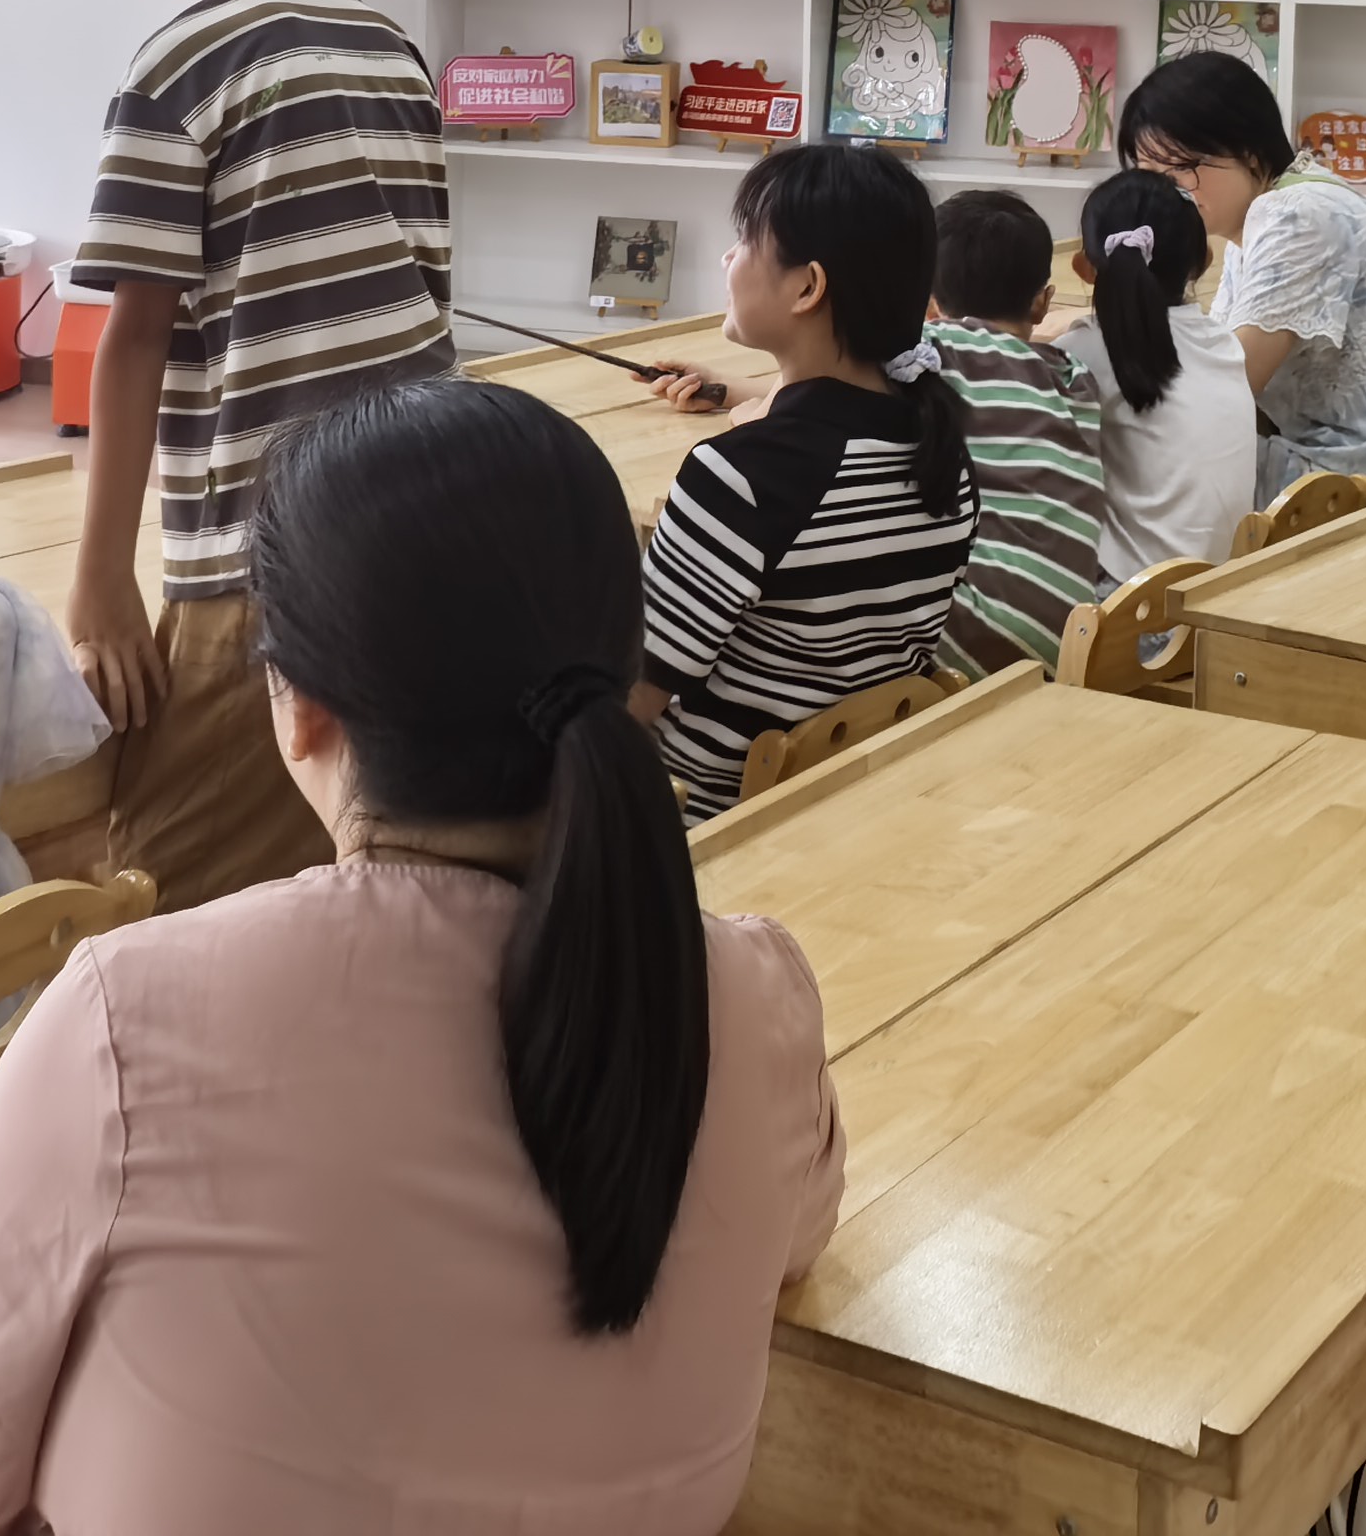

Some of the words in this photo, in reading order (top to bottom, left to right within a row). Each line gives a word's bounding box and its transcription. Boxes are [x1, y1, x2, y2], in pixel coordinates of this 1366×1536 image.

[452, 68, 544, 84] 反对家庭暴力
[458, 87, 565, 105] 促进社会和谐
